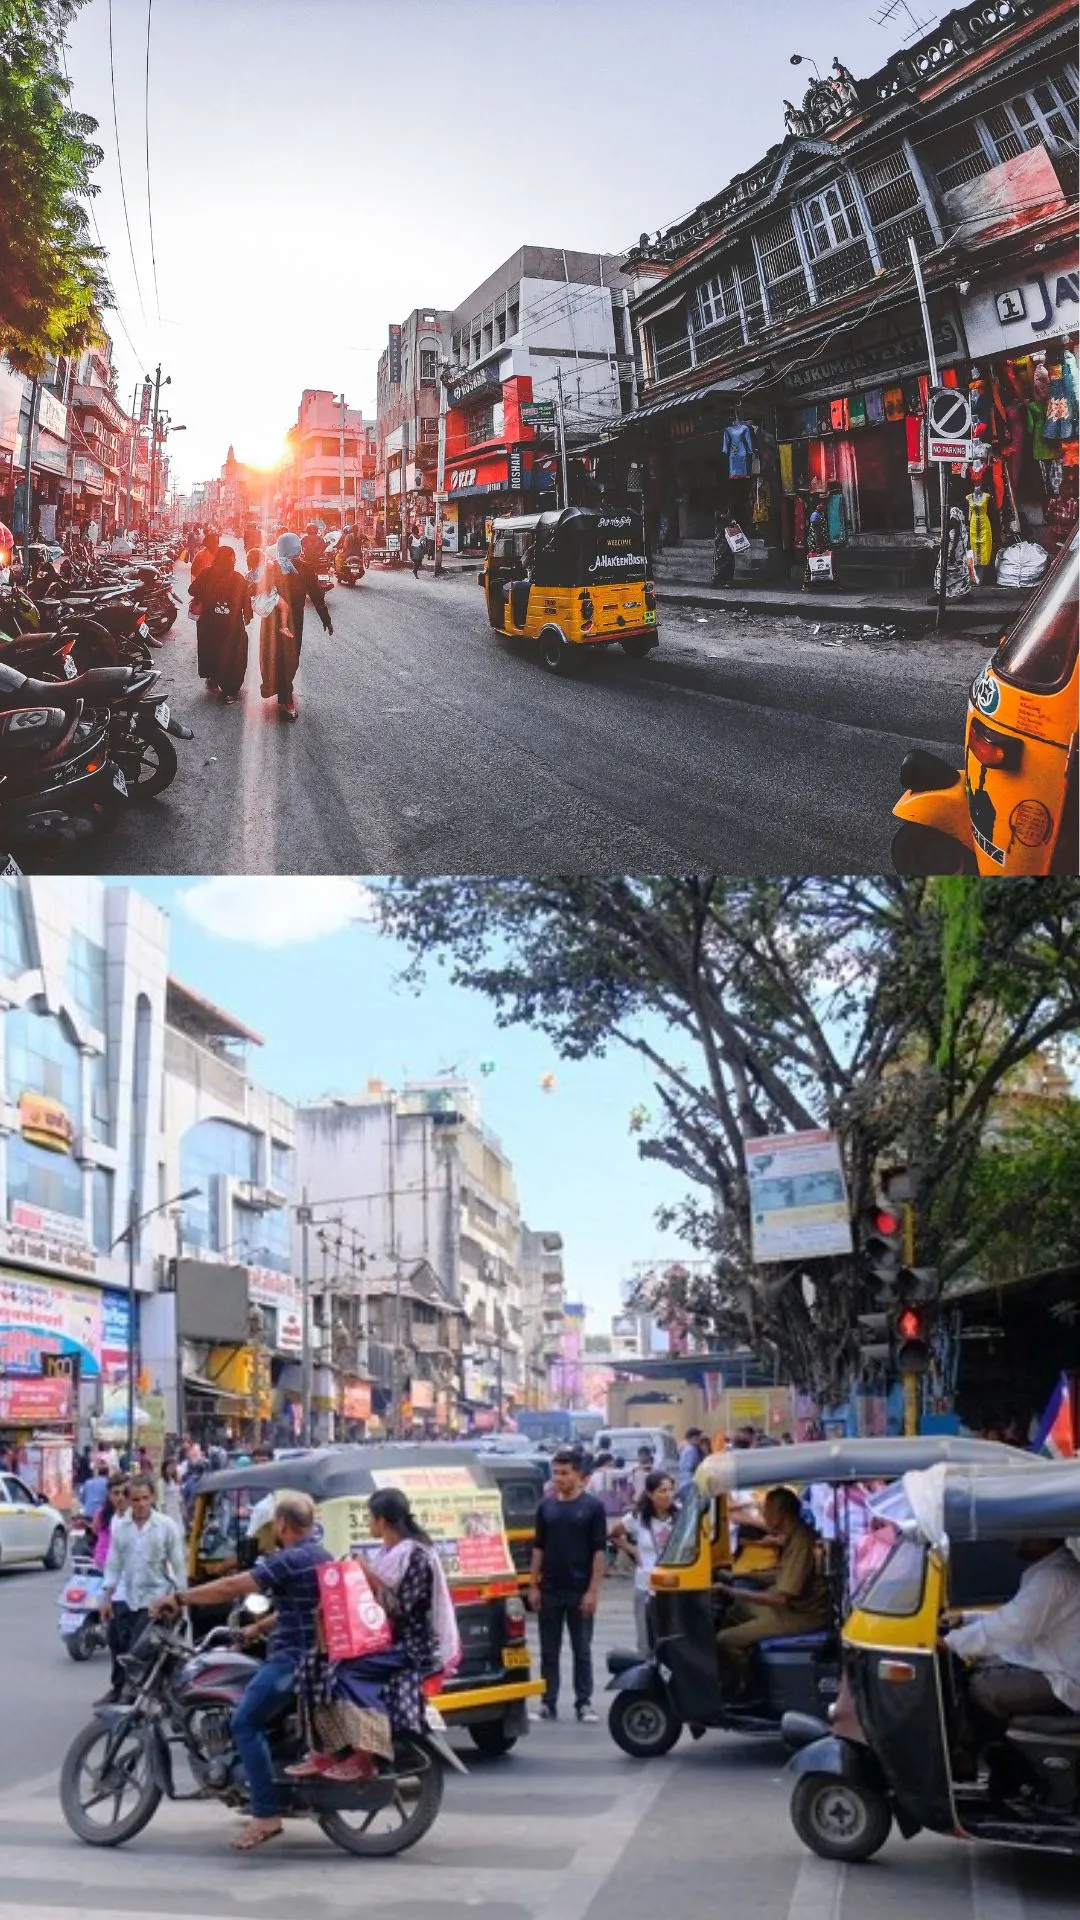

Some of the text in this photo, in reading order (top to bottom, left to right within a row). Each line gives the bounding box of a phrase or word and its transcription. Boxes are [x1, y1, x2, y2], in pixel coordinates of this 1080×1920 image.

[933, 446, 966, 455] NO PARKING
[511, 453, 521, 489] ROSHAN
